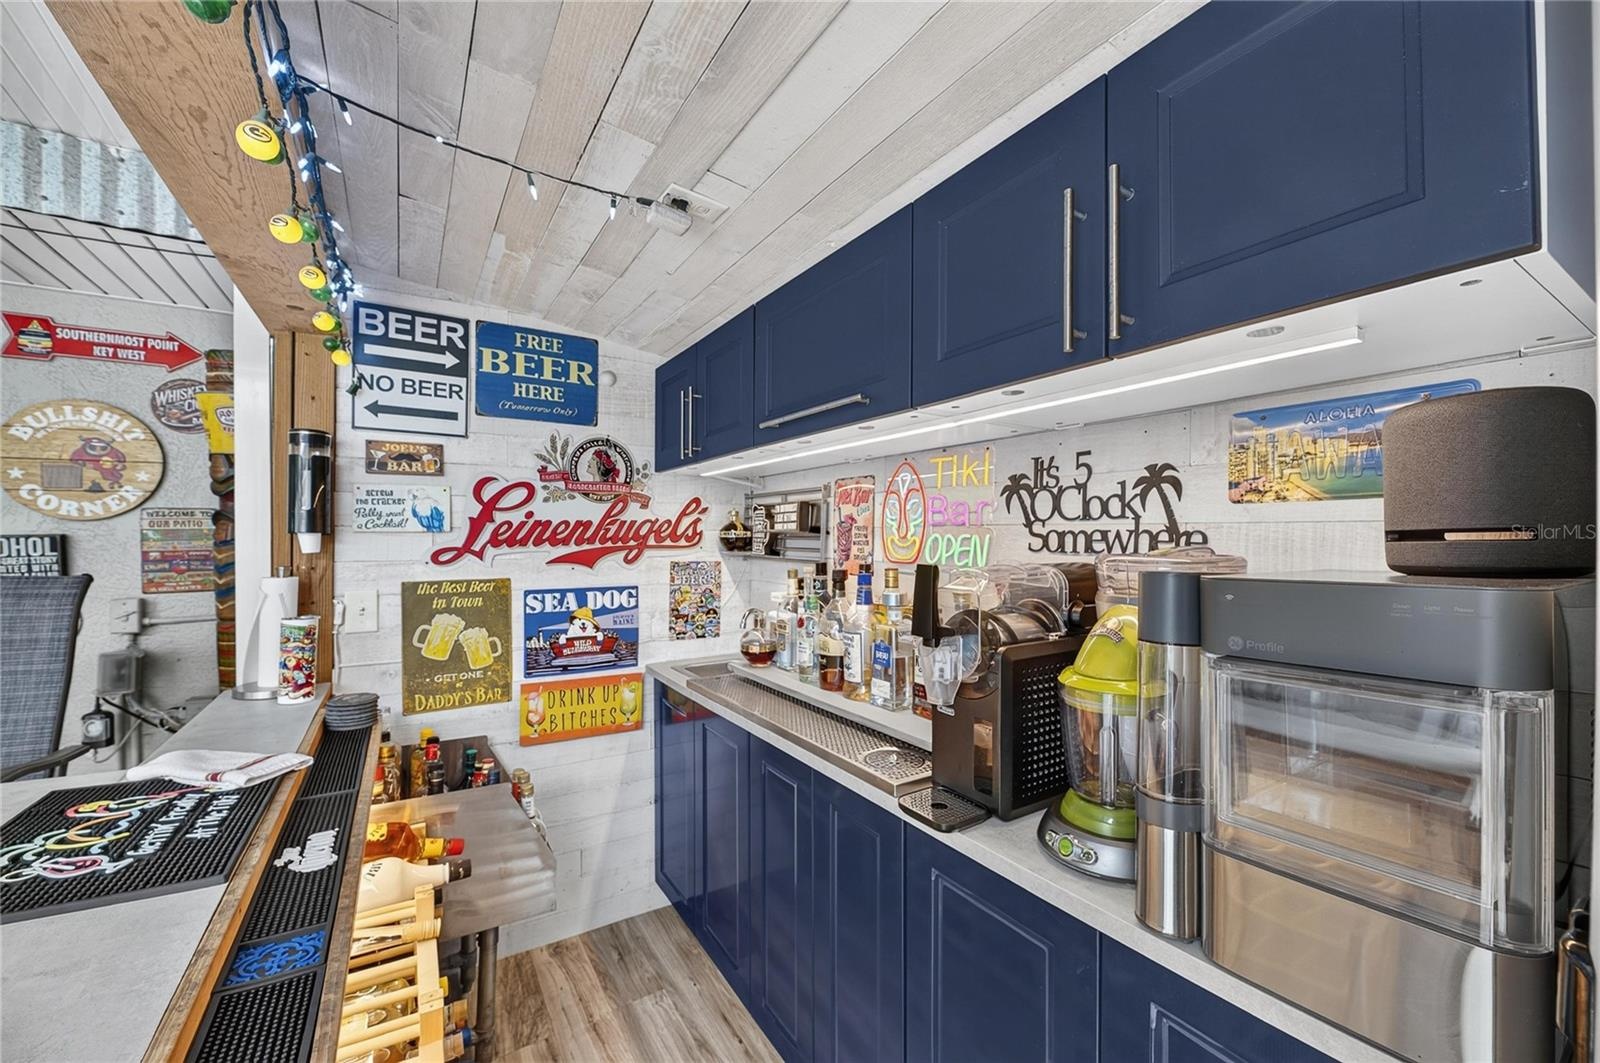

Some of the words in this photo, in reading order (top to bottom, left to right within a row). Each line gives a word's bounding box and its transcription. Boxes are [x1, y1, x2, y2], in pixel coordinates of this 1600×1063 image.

[55, 328, 144, 347] SOUTHERNMOST
[147, 339, 179, 351] POINT
[358, 307, 466, 349] BEER
[93, 346, 114, 357] KEY
[117, 348, 146, 360] WEST
[515, 332, 563, 353] FREE
[479, 346, 595, 386] BEER
[359, 372, 394, 392] NO
[401, 378, 464, 400] BEER
[513, 382, 564, 402] HERE
[8, 405, 145, 441] BULLSHIT
[1304, 405, 1375, 424] ALOHA
[382, 443, 428, 453] JOEL'S
[387, 460, 422, 472] BAR
[1031, 455, 1059, 489] It's
[1073, 450, 1092, 486] 5
[18, 483, 146, 516] CORNER
[928, 494, 991, 527] Bar
[1031, 480, 1142, 522] O'Clock
[148, 520, 170, 528] OUR
[173, 520, 203, 528] PATIO
[354, 507, 383, 520] Polly
[430, 476, 709, 567] Leinenkugel's
[1028, 517, 1208, 554] Somewhere
[925, 533, 990, 567] OPEN
[440, 582, 466, 594] Best
[469, 581, 496, 592] Beer
[432, 597, 446, 609] in
[450, 596, 483, 608] Town
[525, 592, 578, 613] SEA
[586, 589, 637, 609] DOG
[1246, 640, 1284, 653] Profile
[434, 673, 457, 682] GET
[460, 671, 484, 680] ONE
[415, 691, 471, 711] DADDY'S
[476, 688, 501, 703] BAR
[548, 687, 595, 709] DRINK
[603, 684, 619, 702] UP
[550, 707, 618, 732] BITCHES
